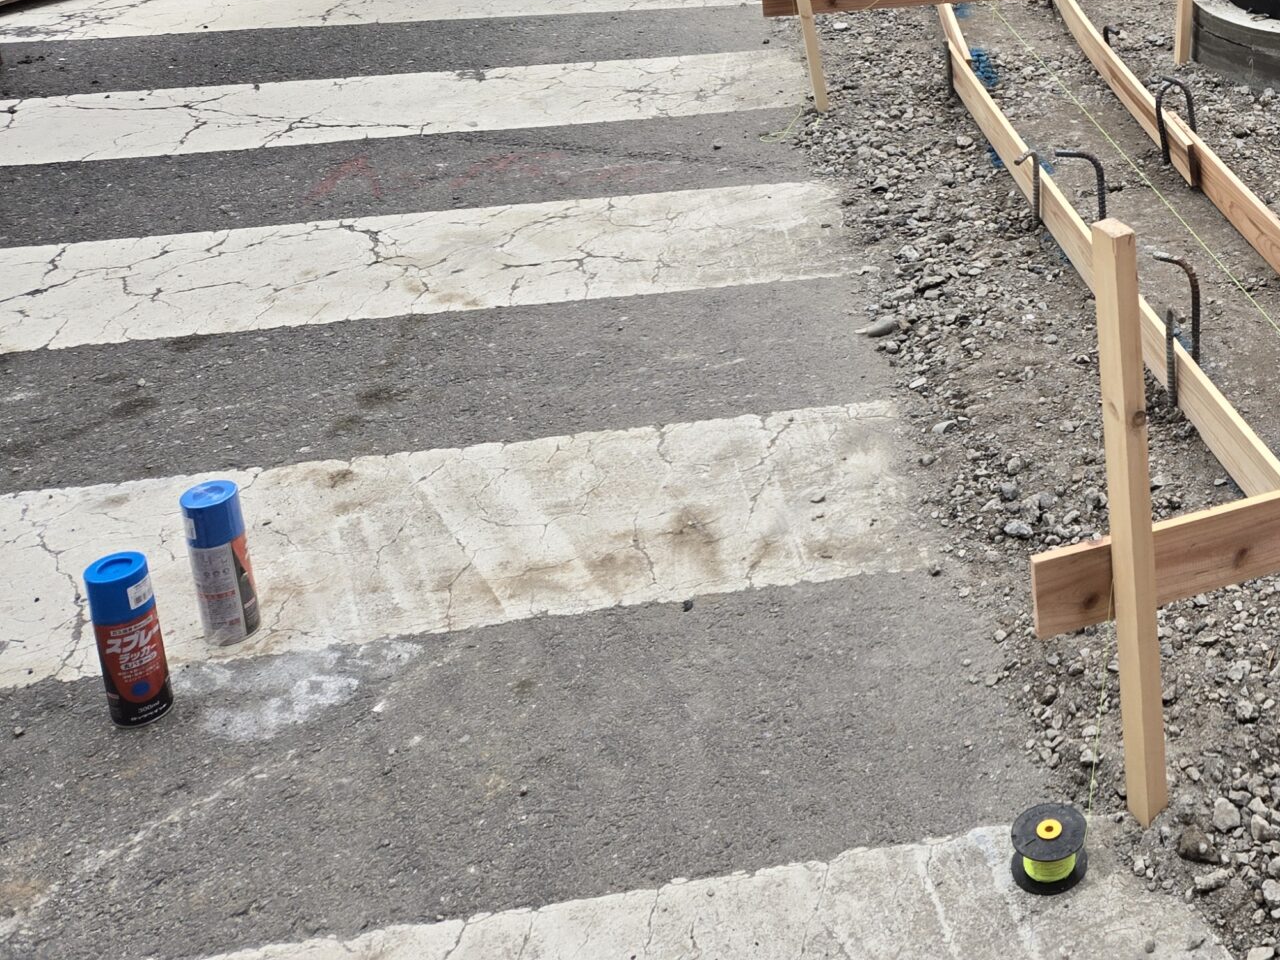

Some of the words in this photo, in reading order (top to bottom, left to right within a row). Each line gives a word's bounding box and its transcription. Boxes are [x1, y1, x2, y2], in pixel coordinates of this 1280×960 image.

[105, 623, 159, 654] スプレー
[118, 643, 157, 664] ラッカー
